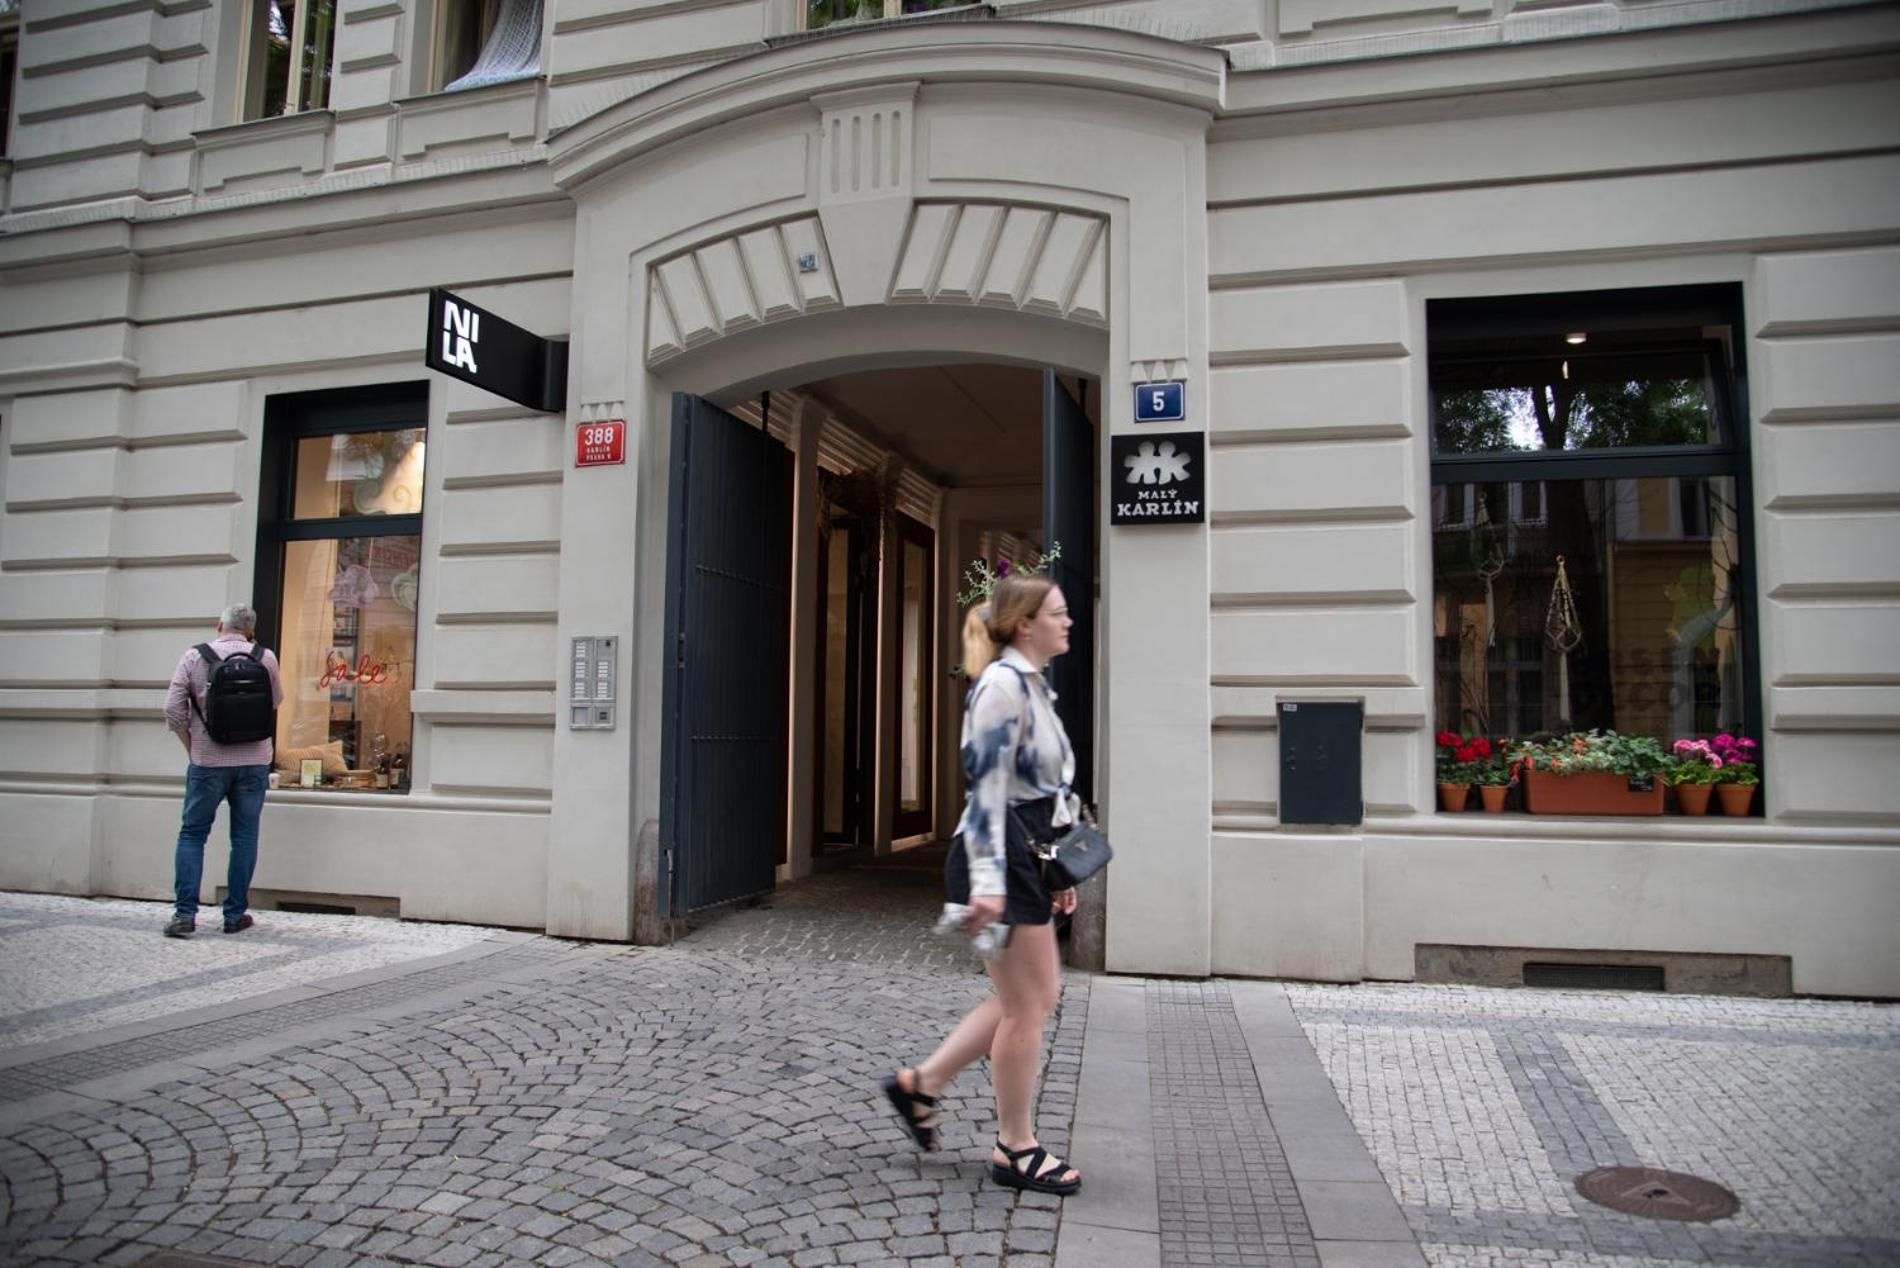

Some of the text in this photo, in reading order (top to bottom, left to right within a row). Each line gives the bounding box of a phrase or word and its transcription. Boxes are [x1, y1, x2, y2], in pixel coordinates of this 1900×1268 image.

[443, 300, 479, 343] NI
[442, 331, 477, 374] LA
[1152, 391, 1164, 411] 5
[585, 427, 614, 445] 388
[1138, 489, 1177, 500] MALÝ
[1117, 500, 1198, 516] KARLÍN
